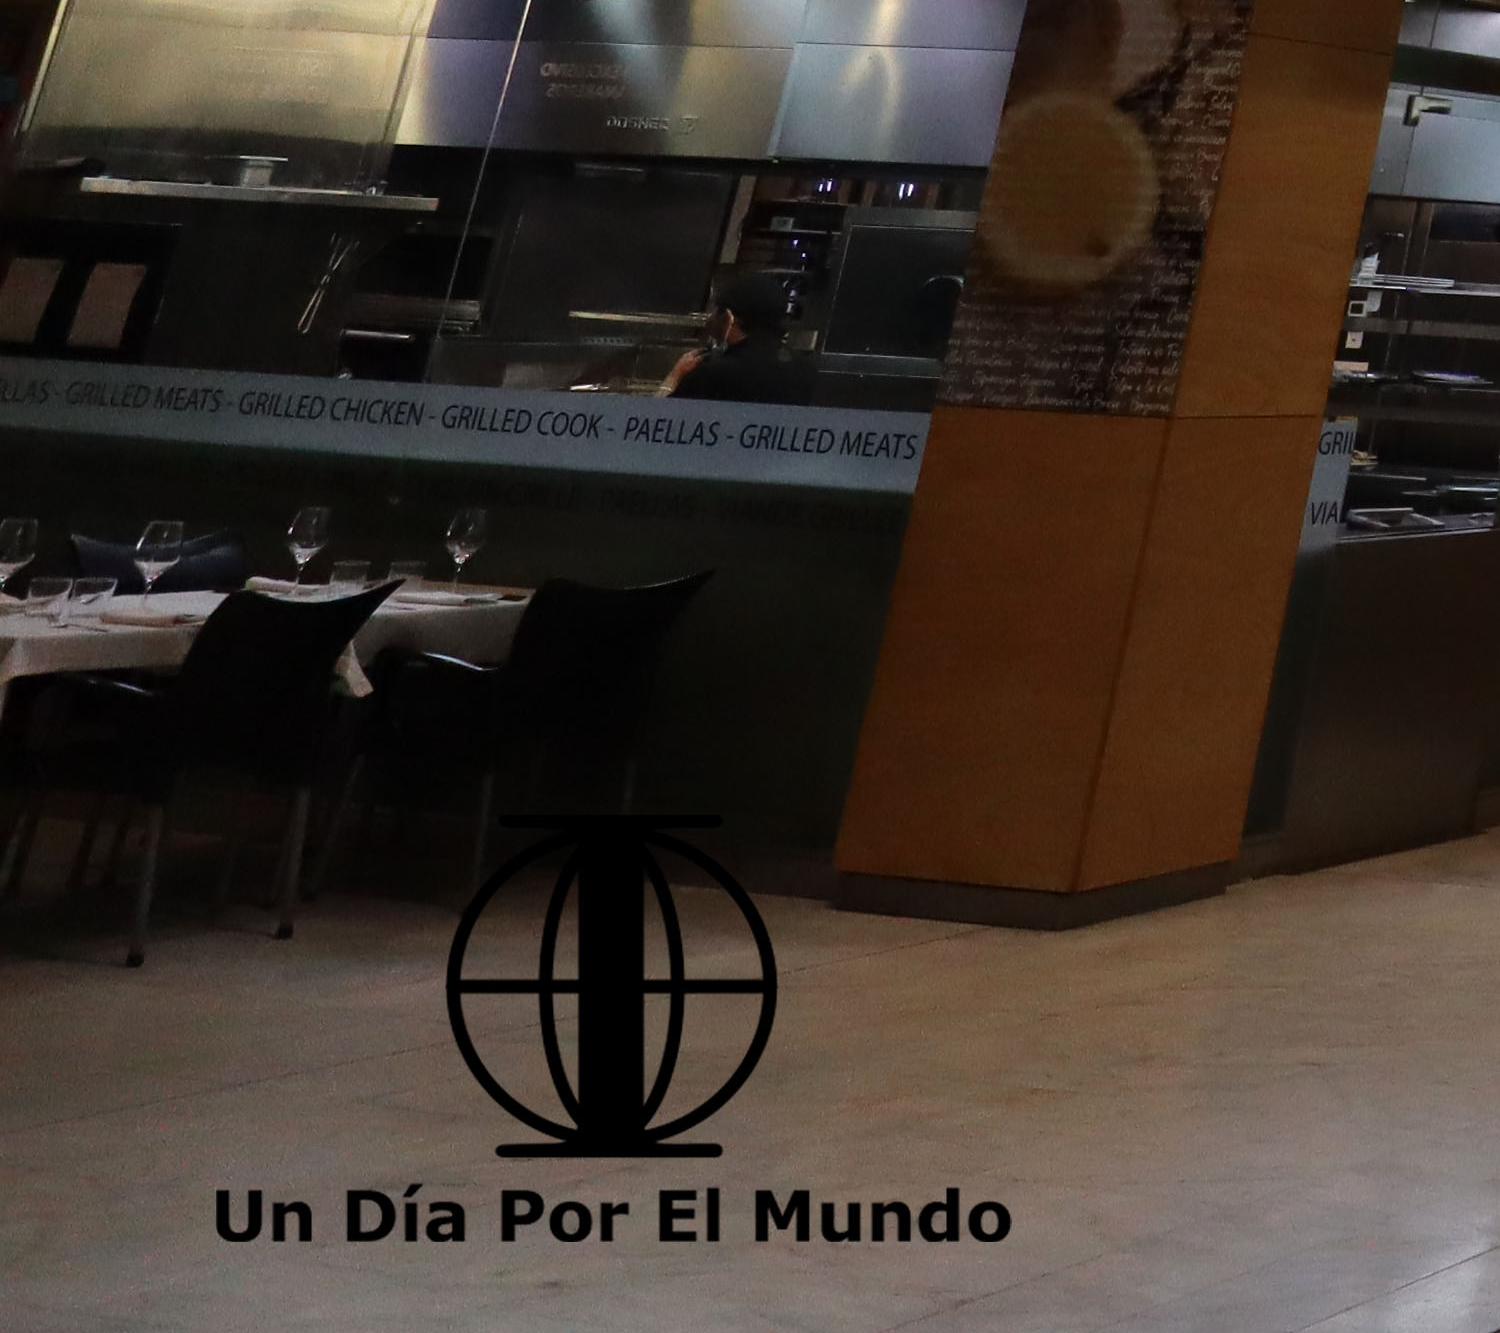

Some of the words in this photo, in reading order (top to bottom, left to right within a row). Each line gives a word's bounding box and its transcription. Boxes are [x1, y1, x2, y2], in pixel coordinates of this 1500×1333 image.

[65, 381, 150, 409] GRILLED
[154, 386, 225, 414] MEATS
[238, 391, 326, 420] GRILLED
[329, 397, 425, 428] CHICKEN
[441, 403, 532, 434] GRILLED
[537, 410, 604, 440] COOK
[623, 416, 721, 447] PAELLAS
[740, 424, 836, 455] GRILLED
[839, 430, 919, 461] MEATS
